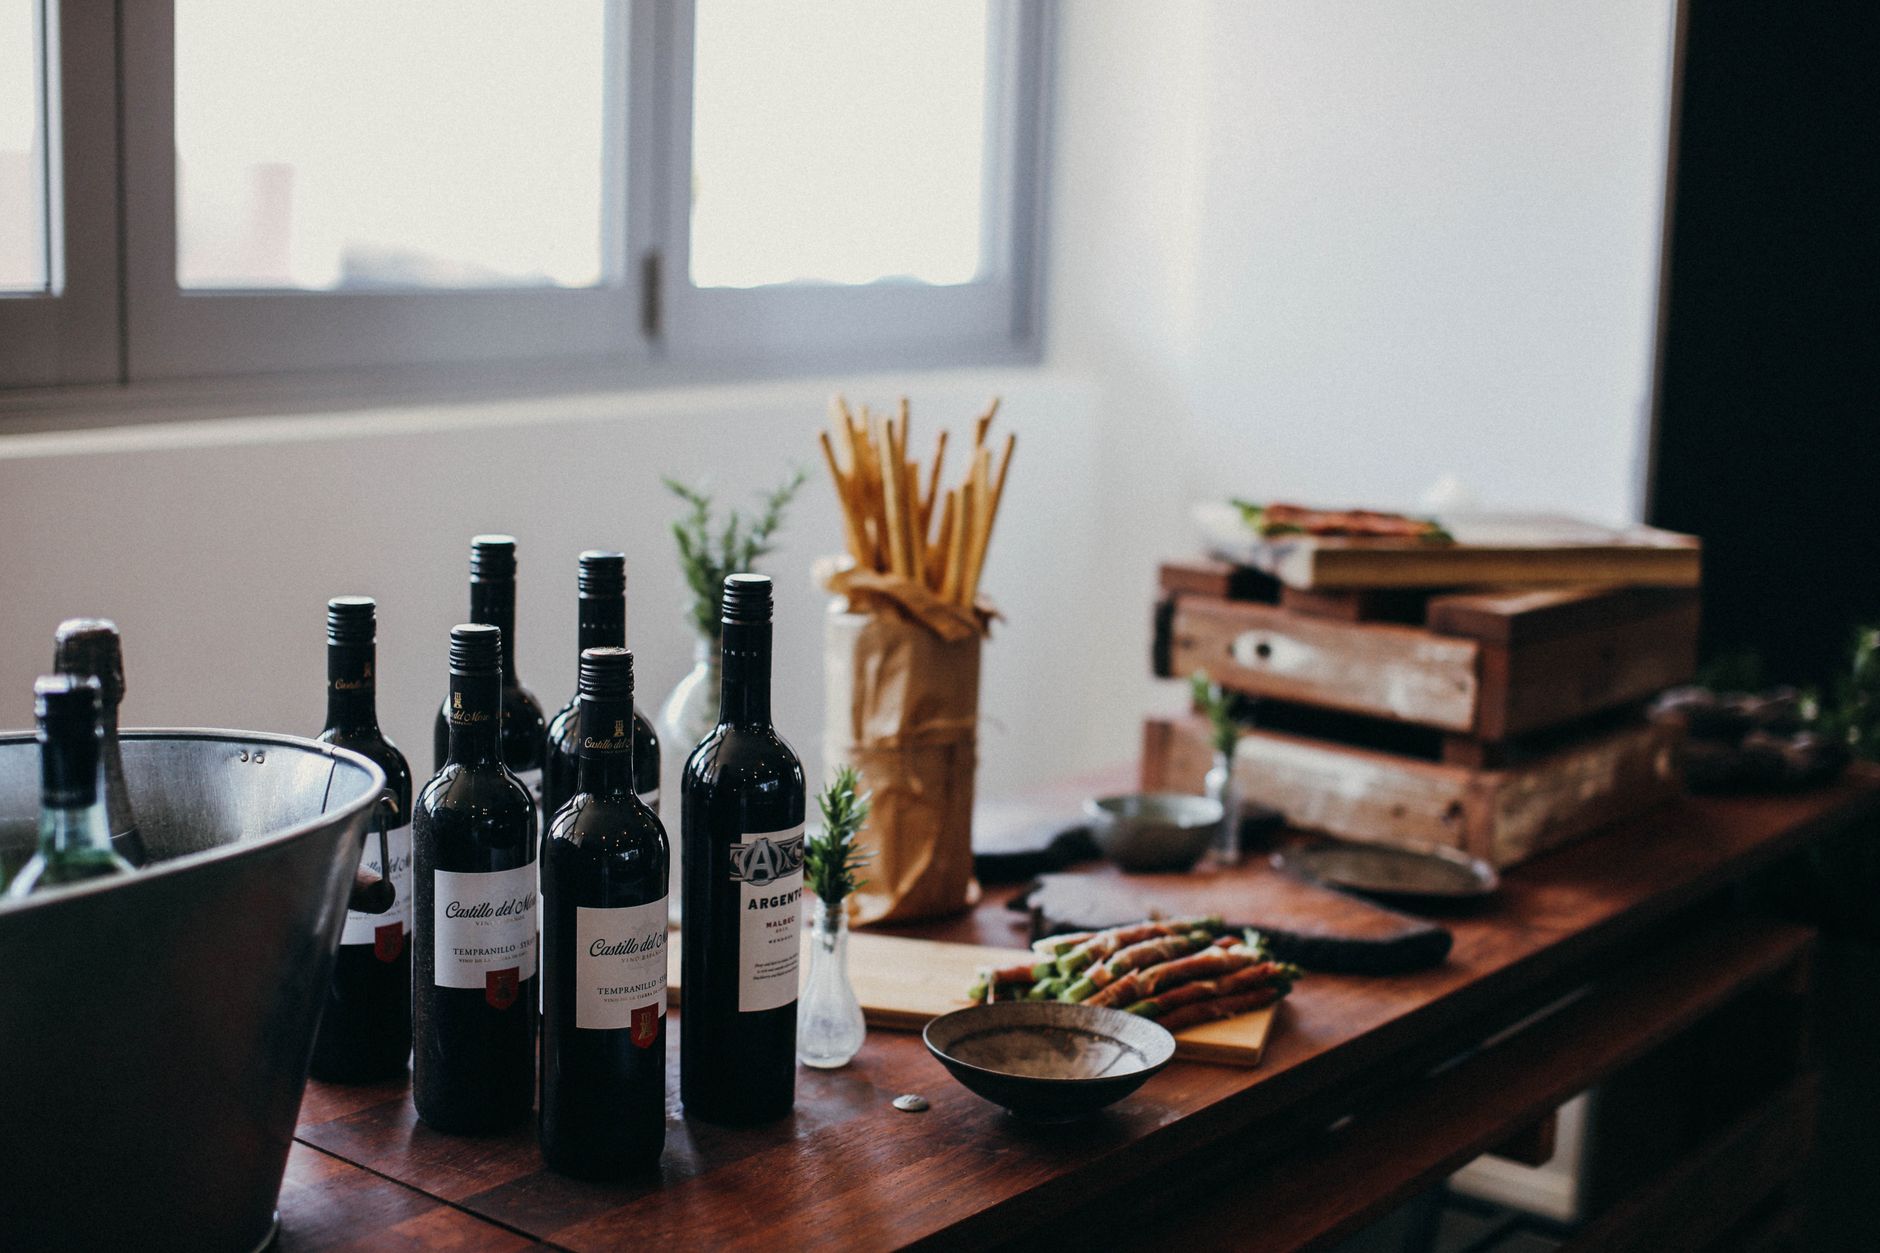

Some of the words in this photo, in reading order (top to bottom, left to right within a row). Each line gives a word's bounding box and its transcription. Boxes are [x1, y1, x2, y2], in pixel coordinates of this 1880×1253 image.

[584, 736, 612, 749] Castillo
[446, 901, 493, 918] Castillo
[495, 899, 515, 917] del
[766, 916, 795, 928] MALBEC
[453, 944, 516, 956] TEMPRANILLO
[589, 938, 639, 957] Castillo
[640, 932, 657, 952] del
[597, 980, 656, 995] TEMPRANILLO
